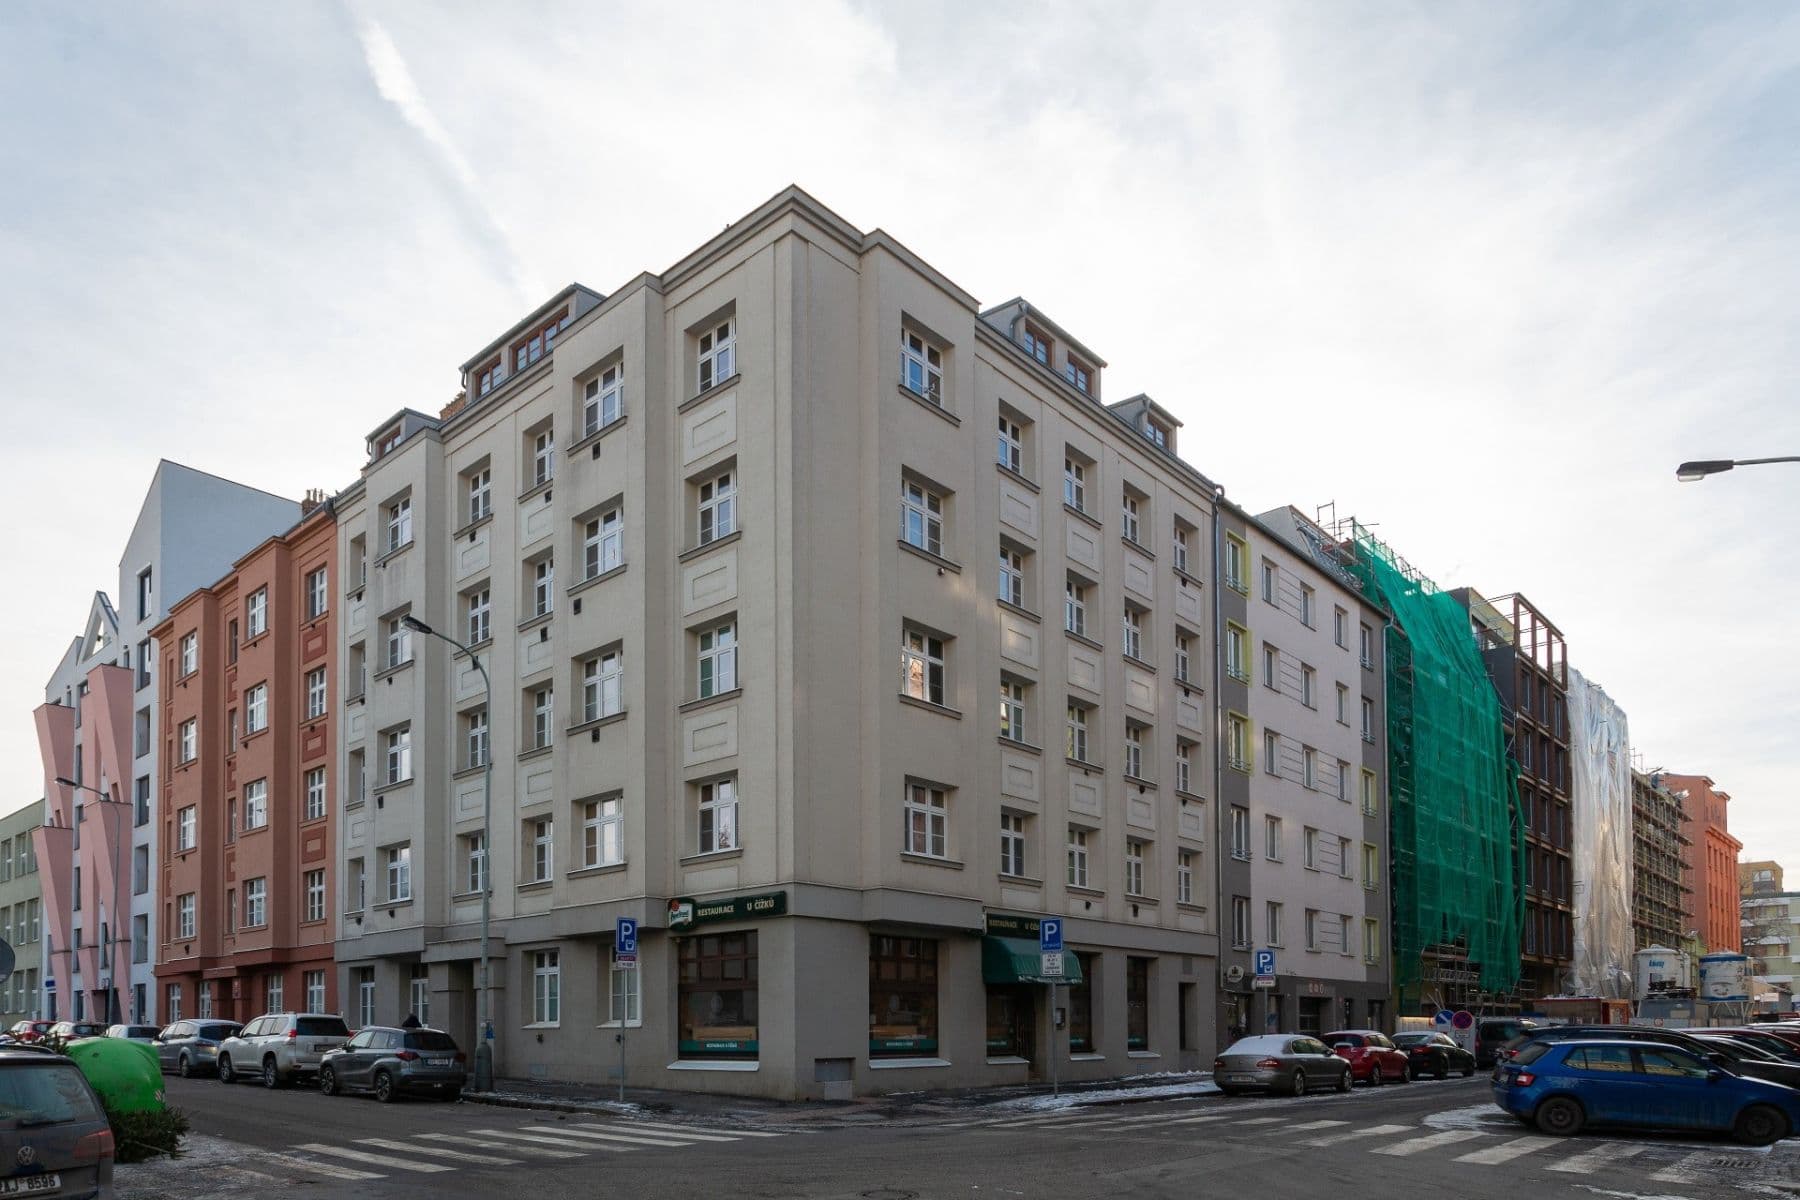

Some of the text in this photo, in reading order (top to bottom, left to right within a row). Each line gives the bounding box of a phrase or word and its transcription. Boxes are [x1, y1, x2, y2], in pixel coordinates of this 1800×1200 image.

[697, 904, 735, 916] RESTAURACE
[747, 901, 753, 911] U
[621, 923, 633, 942] P
[1045, 923, 1058, 941] P
[1260, 953, 1271, 968] P
[27, 1175, 55, 1189] 8596
